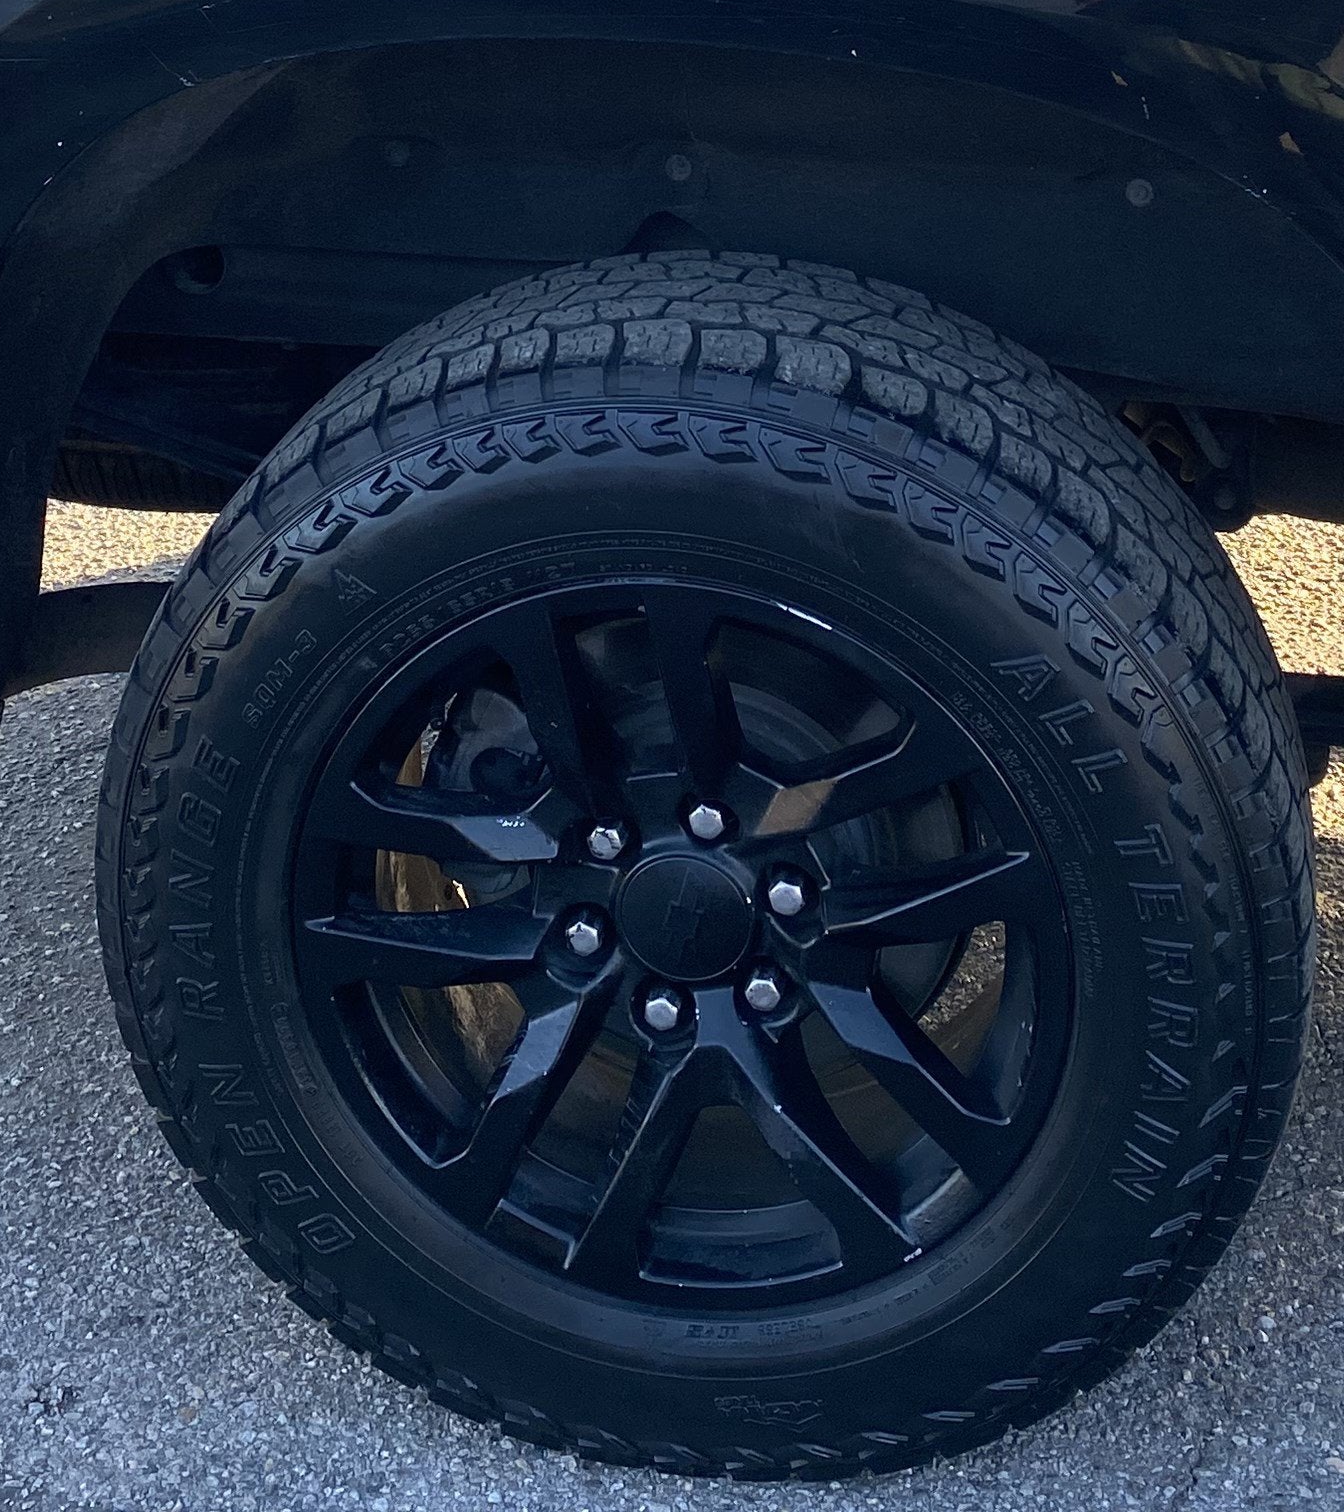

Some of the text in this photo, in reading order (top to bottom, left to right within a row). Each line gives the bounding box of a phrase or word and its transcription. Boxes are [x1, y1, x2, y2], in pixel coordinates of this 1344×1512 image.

[168, 732, 242, 1022] RANGE
[989, 653, 1130, 794] ALL
[1110, 823, 1199, 1203] TERRAIN
[197, 1062, 355, 1255] OPEN
